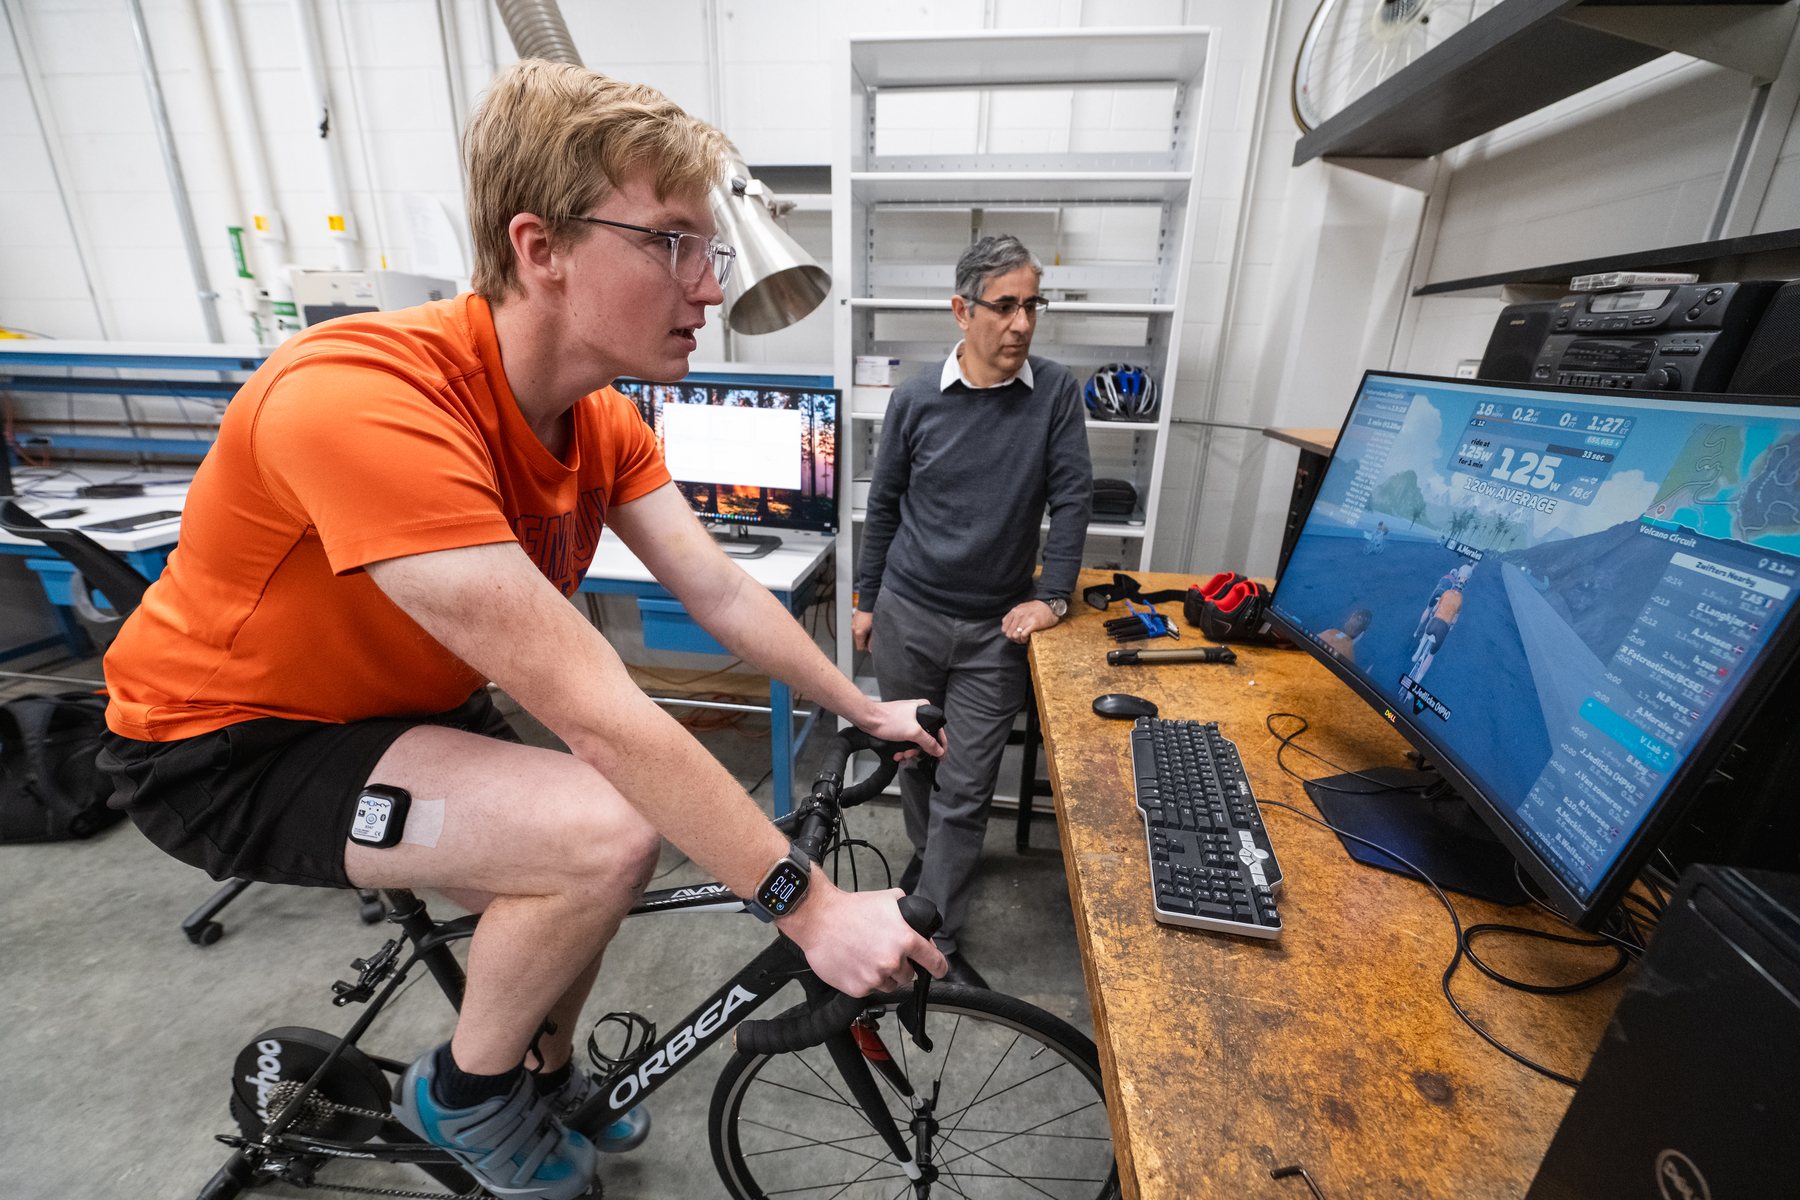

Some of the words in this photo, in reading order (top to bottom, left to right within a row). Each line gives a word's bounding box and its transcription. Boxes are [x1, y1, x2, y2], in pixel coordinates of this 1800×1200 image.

[1476, 403, 1494, 416] 18
[1512, 408, 1532, 422] 0.2
[1586, 416, 1625, 433] 1:27
[1472, 460, 1483, 469] min
[1582, 450, 1592, 458] 33
[1592, 453, 1605, 462] sec
[1496, 486, 1558, 514] AVERAGE
[1640, 525, 1668, 540] Volcano
[1669, 533, 1697, 548] Circuit
[1696, 562, 1727, 577] Zwifters
[1728, 572, 1756, 588] Nearby
[1384, 710, 1396, 723] DELL
[1636, 706, 1675, 736] A.Morales
[1640, 736, 1662, 755] V.Lab
[1580, 748, 1614, 776] J.Jedlicka
[1612, 772, 1637, 794] (HPH)
[1578, 800, 1610, 831] R.Iversen
[770, 876, 796, 902] 10:13
[609, 984, 758, 1110] ORBEA
